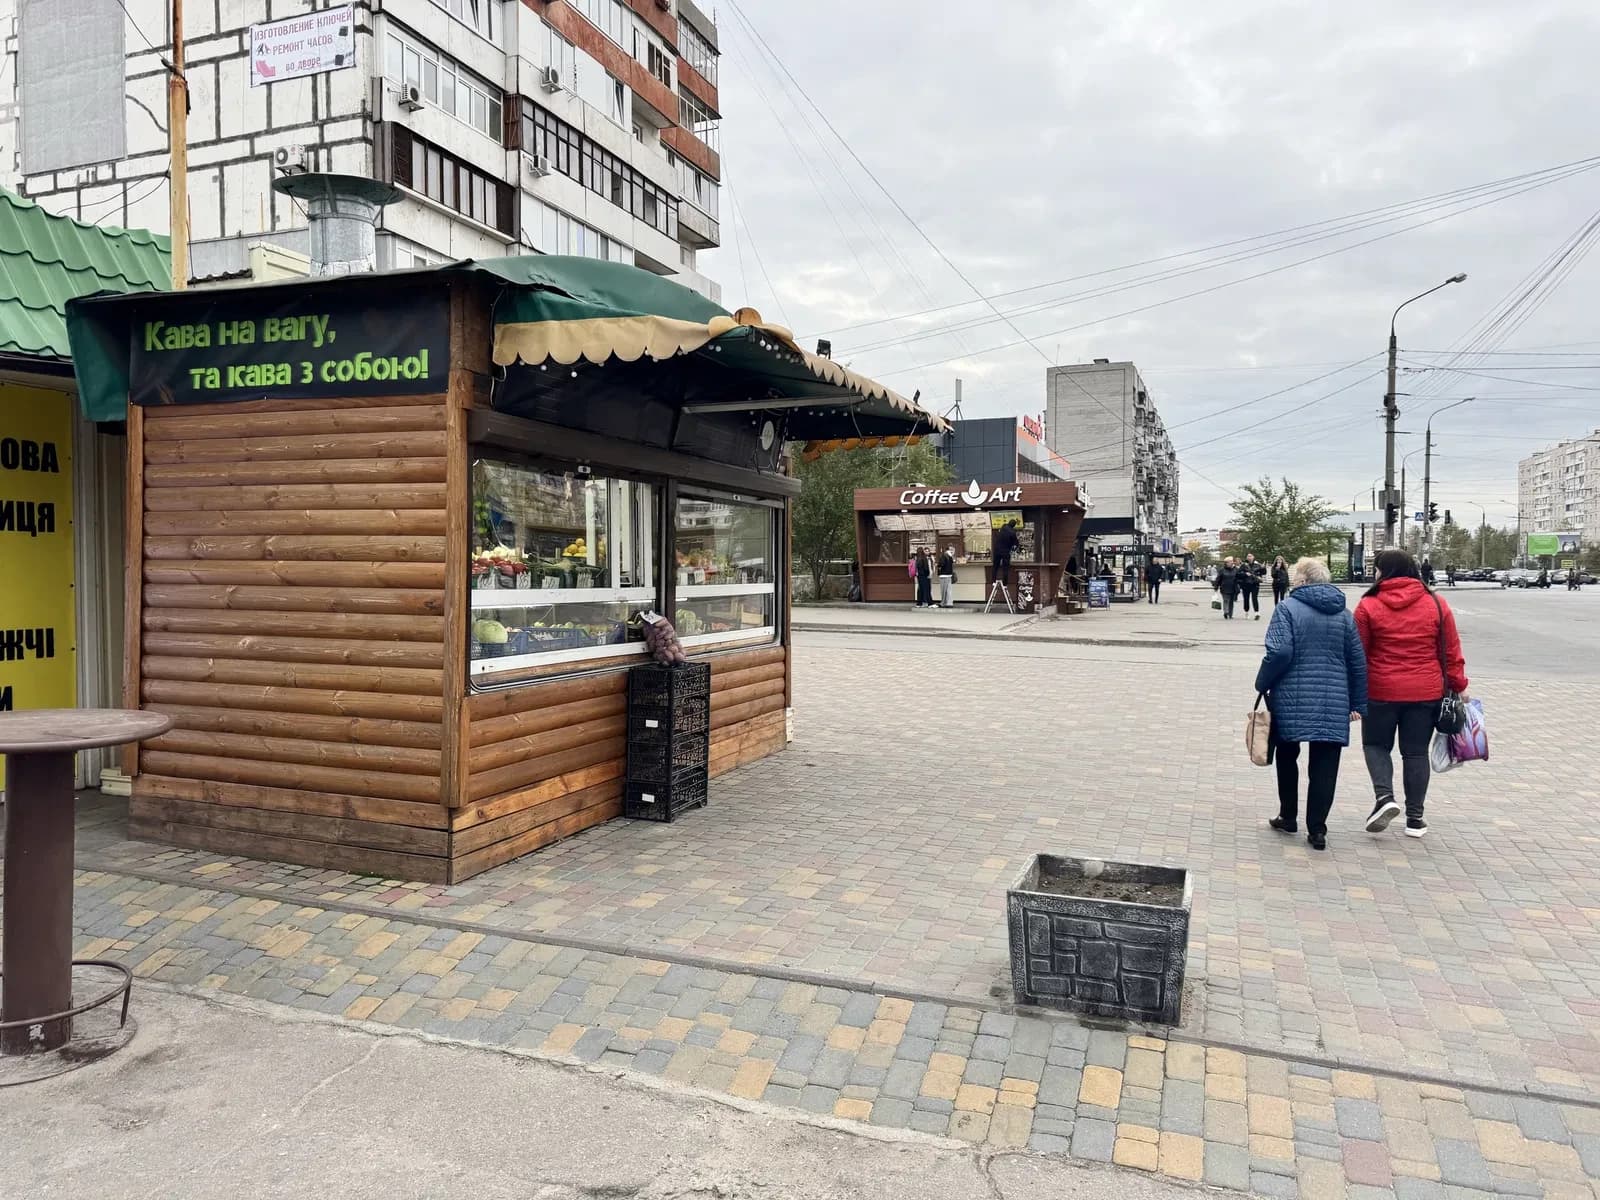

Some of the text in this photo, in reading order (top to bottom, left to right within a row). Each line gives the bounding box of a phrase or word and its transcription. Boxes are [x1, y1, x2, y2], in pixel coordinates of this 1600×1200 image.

[254, 9, 352, 41] ИЗГОТОВЛЕНИЕ КЛЮЧЕЙ
[273, 34, 333, 56] РЕМОНТ ЧАСОВ
[145, 314, 337, 351] Кава на вагу,
[189, 348, 429, 390] та кава з собою!
[1, 437, 60, 473] ОВА
[900, 486, 1023, 505] Coffee Art
